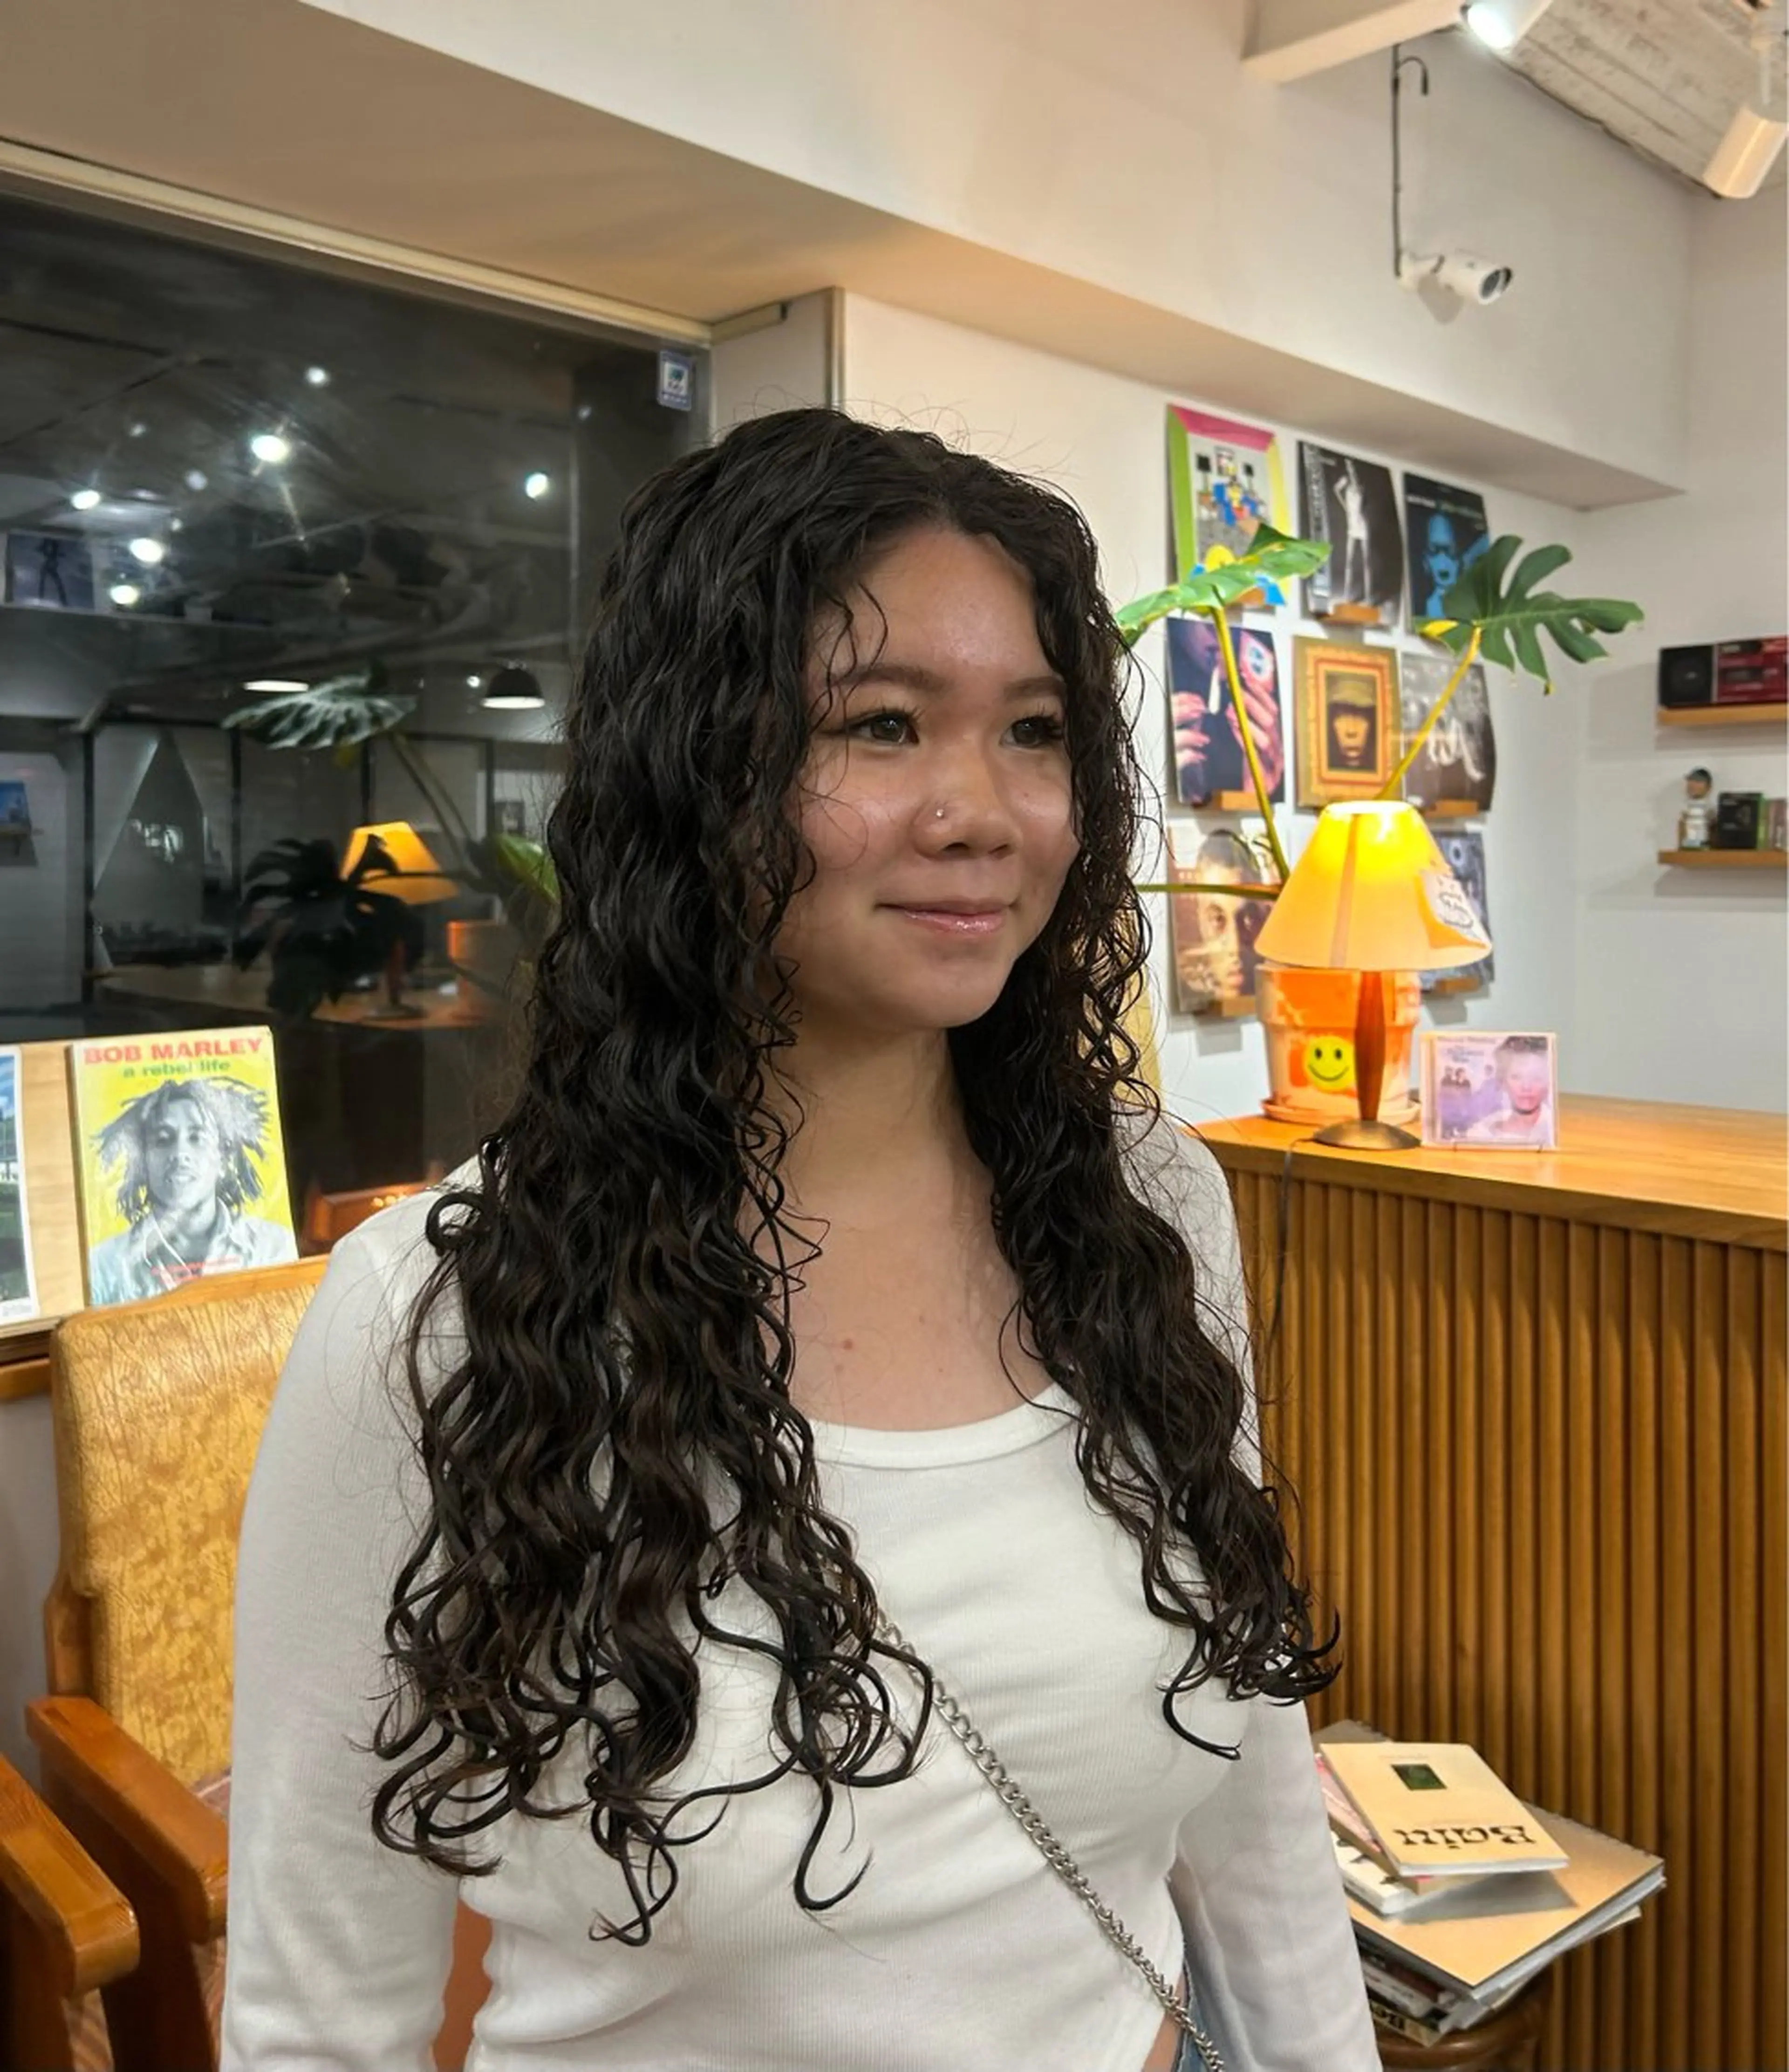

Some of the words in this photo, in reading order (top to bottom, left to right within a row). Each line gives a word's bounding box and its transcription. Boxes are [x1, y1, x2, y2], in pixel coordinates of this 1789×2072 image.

[84, 1046, 142, 1064] BOB
[151, 1039, 262, 1060] MARLEY
[123, 1067, 135, 1077] a
[143, 1062, 192, 1076] rebel
[201, 1059, 231, 1072] life
